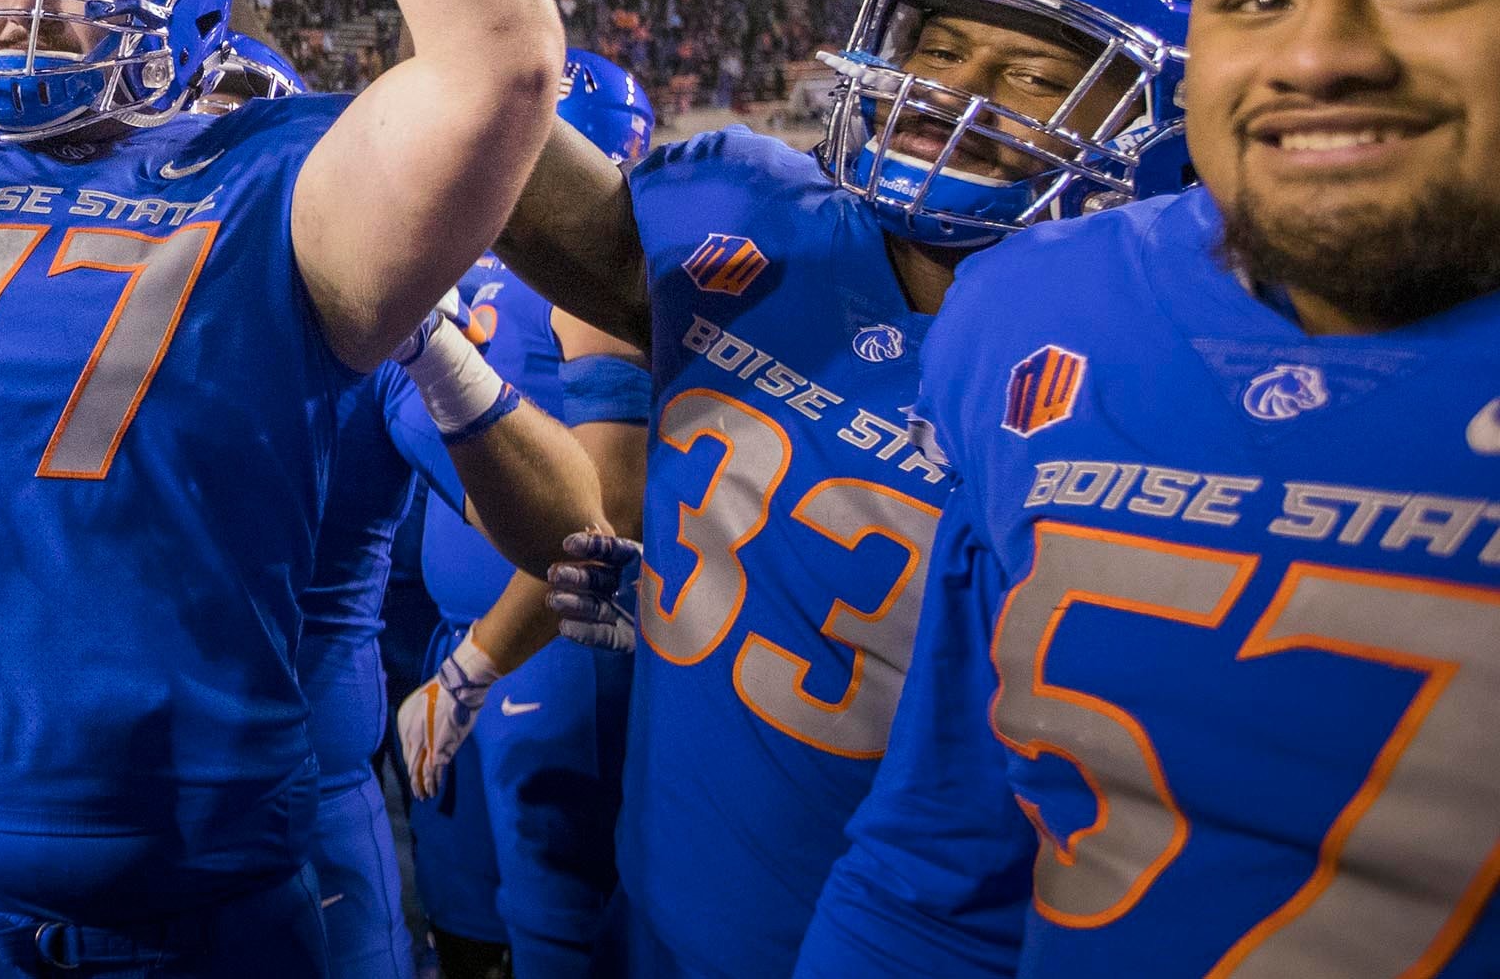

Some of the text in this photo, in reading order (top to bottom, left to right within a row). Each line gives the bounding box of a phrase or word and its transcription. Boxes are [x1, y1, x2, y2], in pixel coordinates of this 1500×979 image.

[681, 314, 844, 421] BOISE
[639, 388, 944, 759] 33
[1024, 461, 1263, 526] BOISE
[990, 520, 1500, 979] 57
